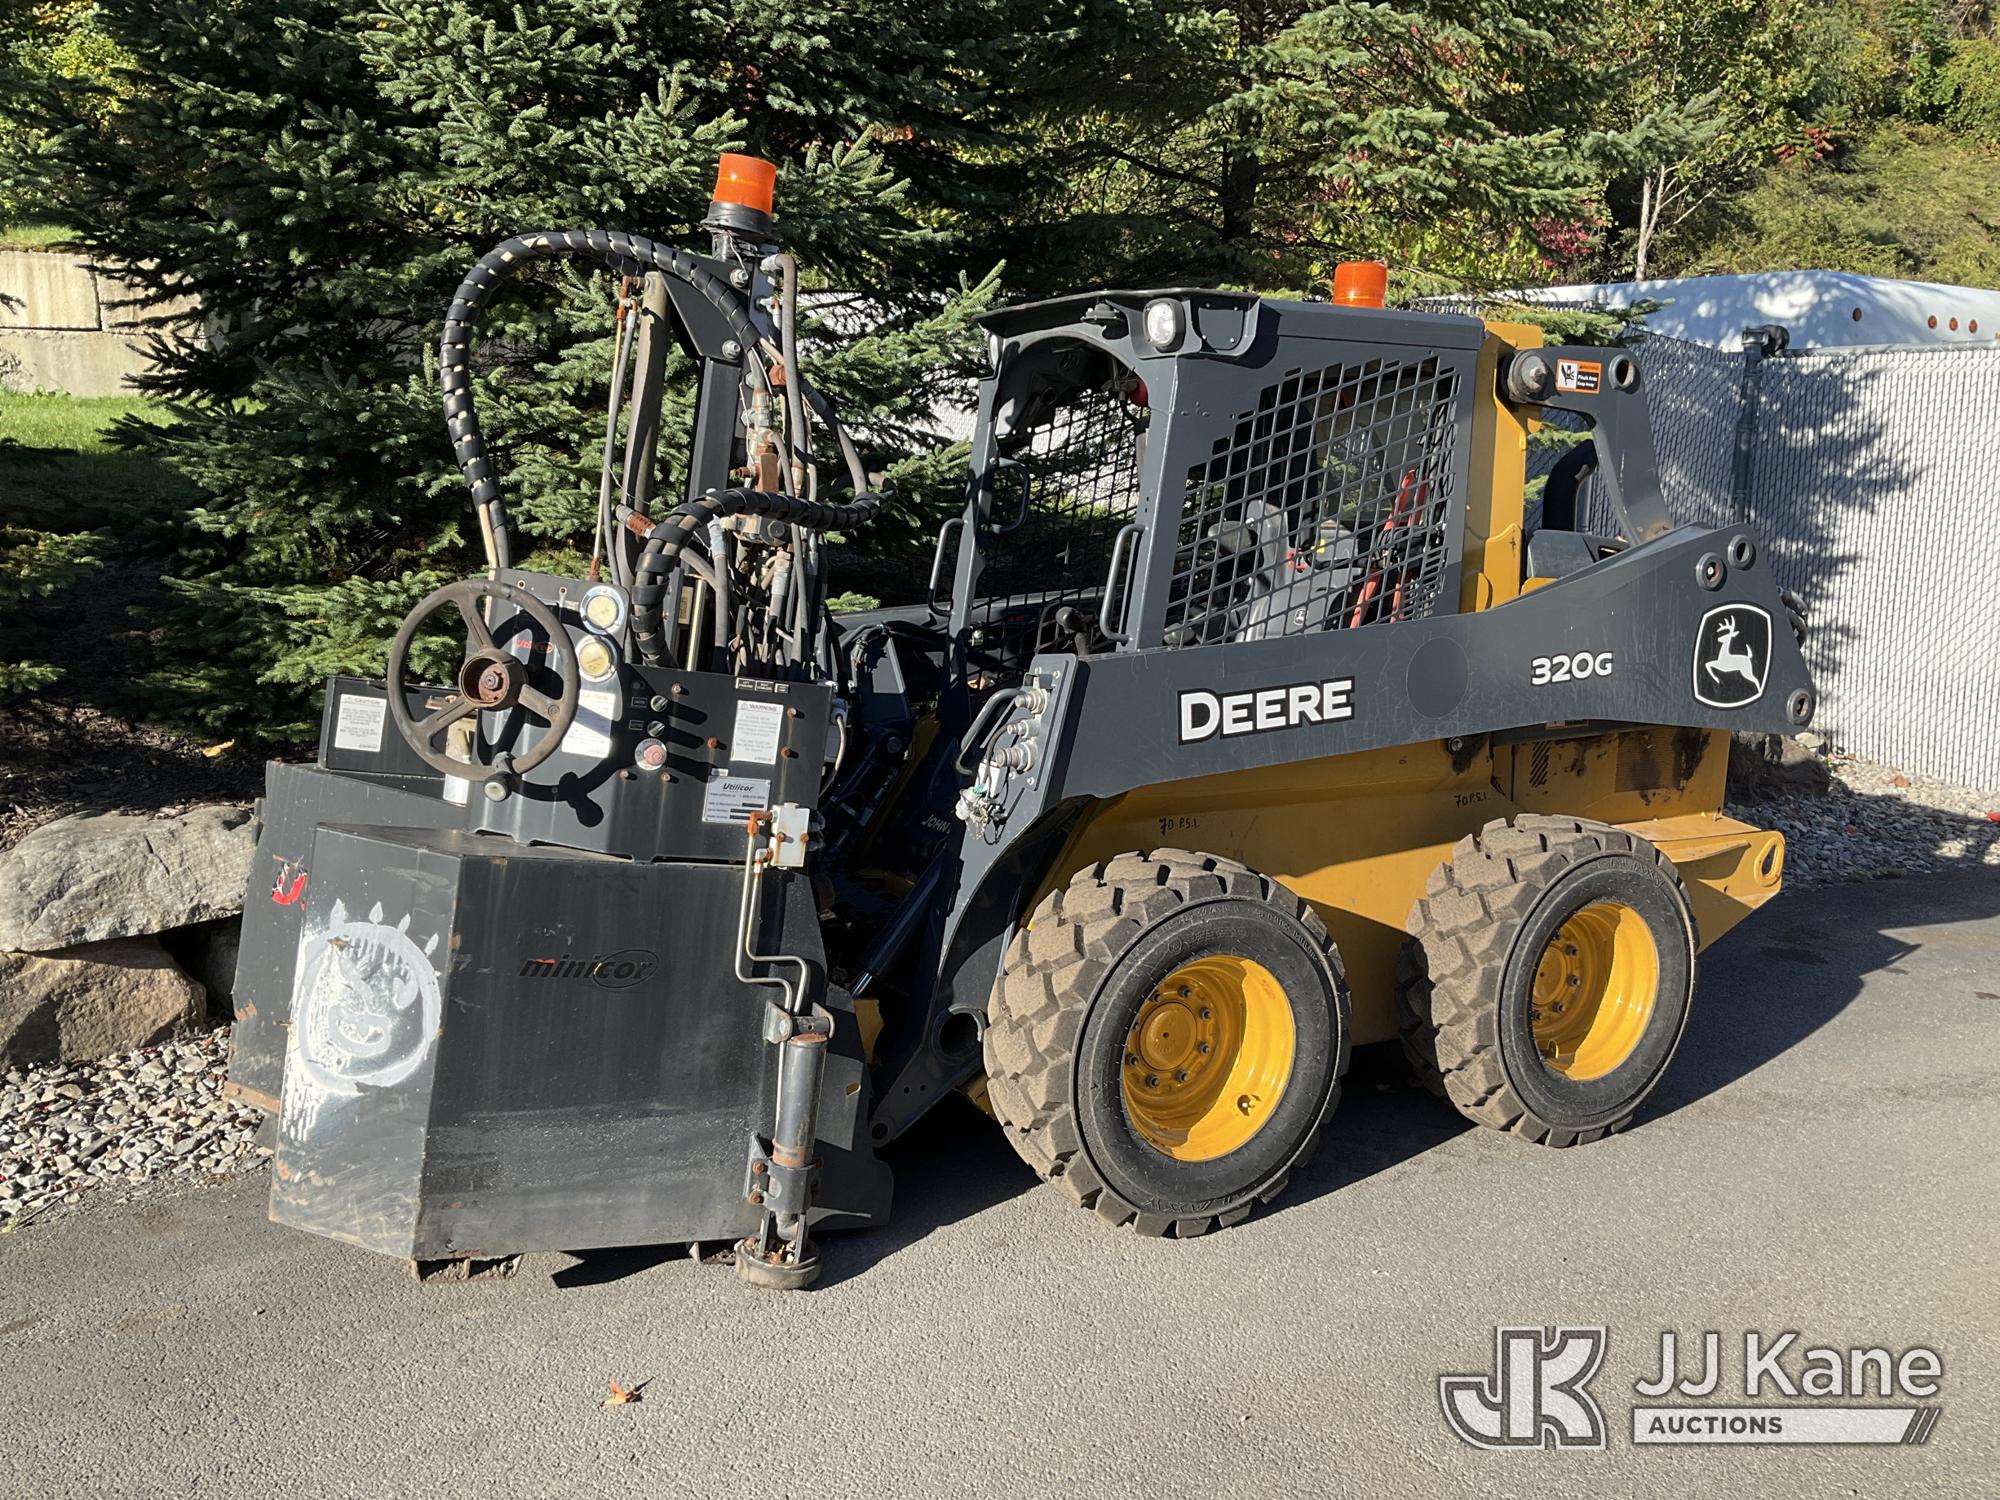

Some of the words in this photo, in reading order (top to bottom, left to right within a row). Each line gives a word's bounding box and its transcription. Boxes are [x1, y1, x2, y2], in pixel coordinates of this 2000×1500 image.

[1531, 653, 1613, 686] 320G
[744, 703, 778, 712] WARNING
[1181, 680, 1352, 741] DEERE
[723, 783, 754, 792] Utilicor
[519, 954, 653, 979] minicor
